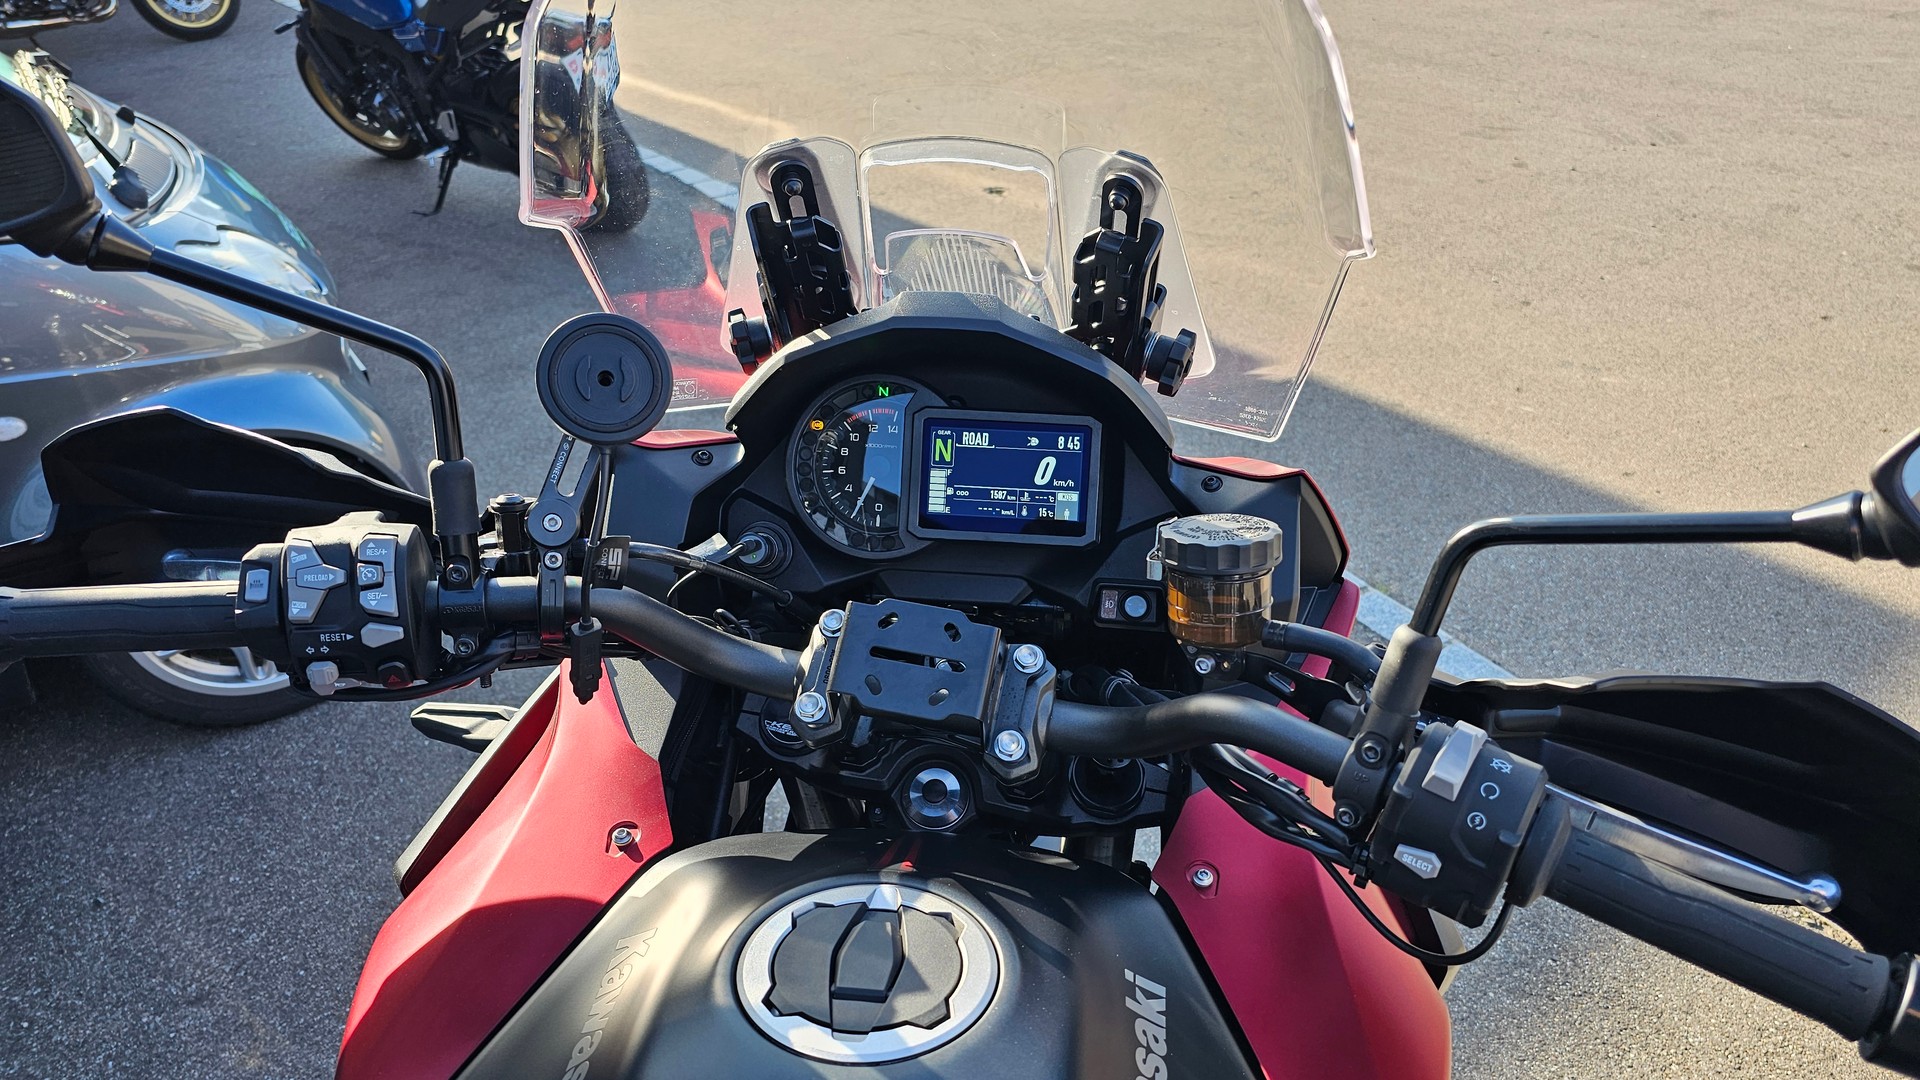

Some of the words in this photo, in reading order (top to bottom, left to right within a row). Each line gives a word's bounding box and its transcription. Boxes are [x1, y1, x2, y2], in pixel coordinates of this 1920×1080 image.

[878, 386, 889, 397] N
[868, 424, 878, 433] 12
[887, 425, 898, 433] 14
[849, 433, 859, 441] 10
[962, 431, 989, 446] ROAD
[840, 447, 848, 456] 8
[935, 438, 952, 461] N
[550, 451, 566, 484] CONNECT
[838, 466, 846, 474] 6
[1034, 456, 1057, 486] 0
[1053, 479, 1074, 488] km/h
[844, 484, 852, 492] 4
[990, 490, 1007, 499] 1587
[875, 503, 882, 511] 0
[1039, 507, 1047, 517] 15
[366, 548, 388, 556] RES/+
[608, 547, 623, 581] SP
[303, 574, 328, 582] PRELOAD
[320, 633, 345, 642] RESET
[1401, 853, 1433, 873] SELECT
[1124, 968, 1168, 1080] saki
